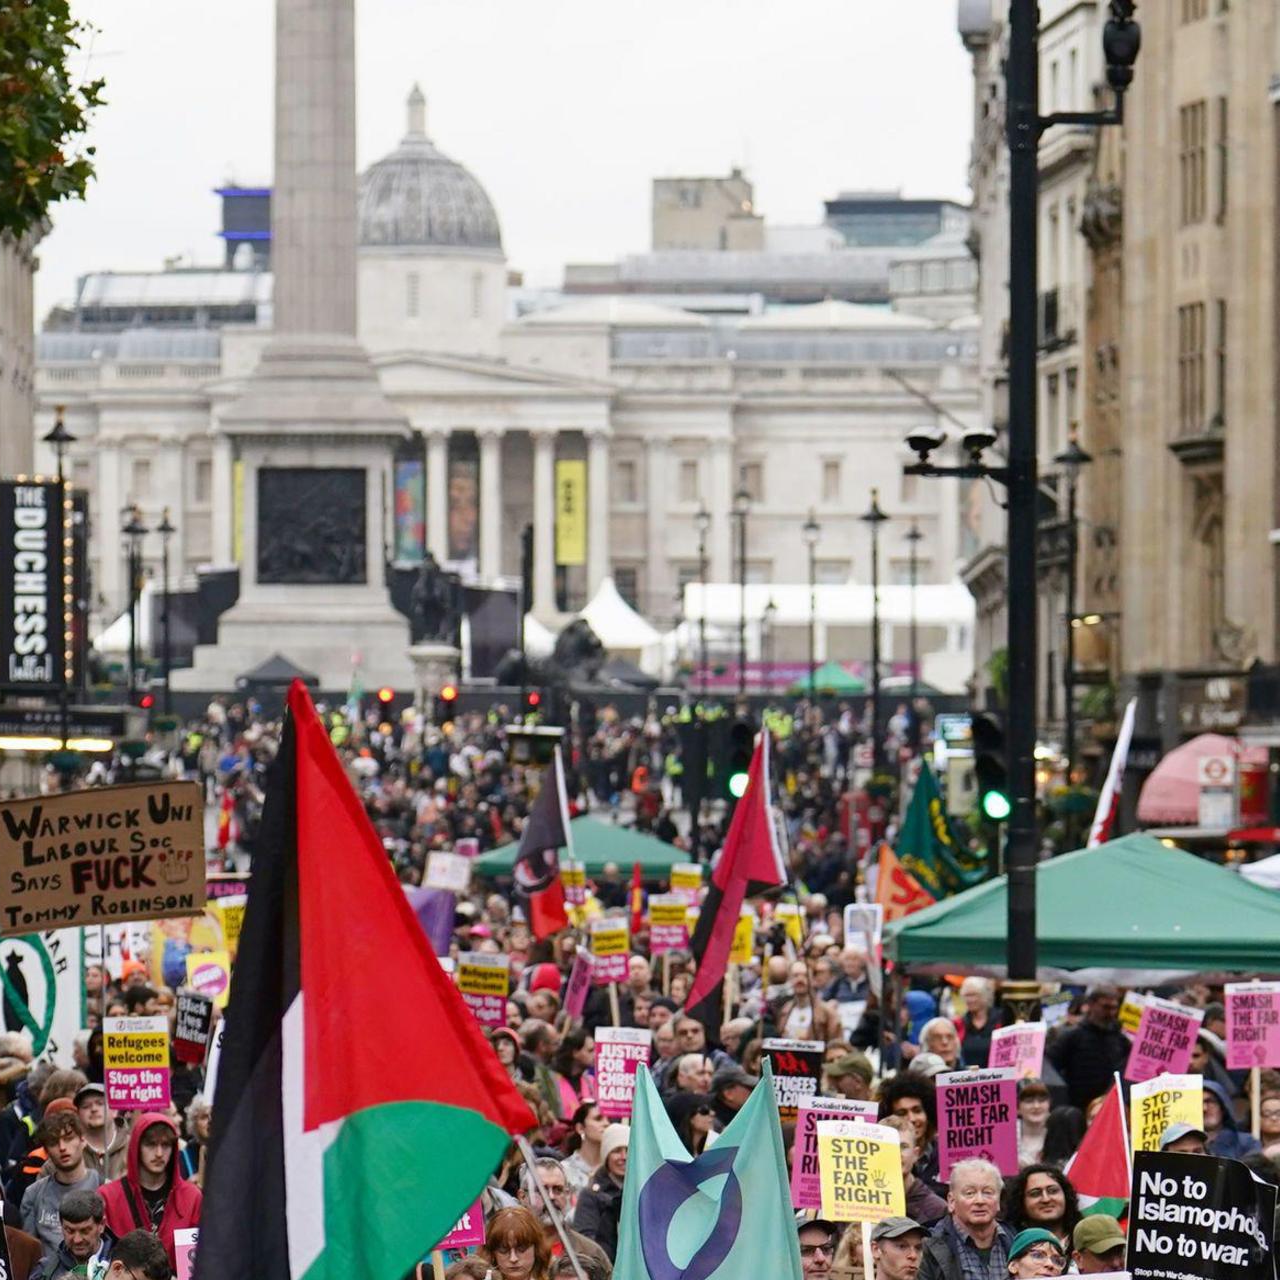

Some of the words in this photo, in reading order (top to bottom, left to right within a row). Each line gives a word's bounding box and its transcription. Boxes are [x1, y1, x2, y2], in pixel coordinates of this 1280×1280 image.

[14, 486, 46, 507] THE
[13, 507, 48, 655] DUCHESS
[2, 806, 140, 842] WARWICK
[147, 792, 193, 825] UNI
[22, 837, 119, 867] LABOUR
[11, 871, 62, 894] SAYS
[71, 853, 156, 895] FUCK
[5, 902, 80, 927] TOMMY
[91, 894, 194, 917] ROBINSON
[177, 998, 207, 1014] Black
[1231, 994, 1273, 1010] SMASH
[177, 1012, 203, 1027] Lives
[1232, 1011, 1253, 1026] THE
[1256, 1010, 1279, 1025] FAR
[107, 1035, 165, 1050] Refugees
[176, 1026, 208, 1043] Matter
[1232, 1027, 1267, 1042] RIGHT
[108, 1050, 163, 1063] welcome
[598, 1044, 649, 1060] JUSTICE
[598, 1059, 625, 1073] FOR
[598, 1072, 636, 1088] CHRIS
[598, 1086, 632, 1101] KABA
[945, 1084, 1001, 1108] SMASH
[945, 1107, 977, 1128] THE
[980, 1103, 1010, 1125] FAR
[946, 1125, 996, 1149] RIGHT
[831, 1138, 880, 1156] STOP
[834, 1155, 869, 1171] THE
[833, 1171, 868, 1188] FAR
[1140, 1171, 1178, 1197] No
[1182, 1175, 1207, 1200] to
[834, 1187, 893, 1206] RIGHT
[1137, 1197, 1270, 1251] Islamophoa.
[1135, 1229, 1173, 1254] No
[1176, 1233, 1197, 1257] to
[1200, 1241, 1249, 1267] war.
